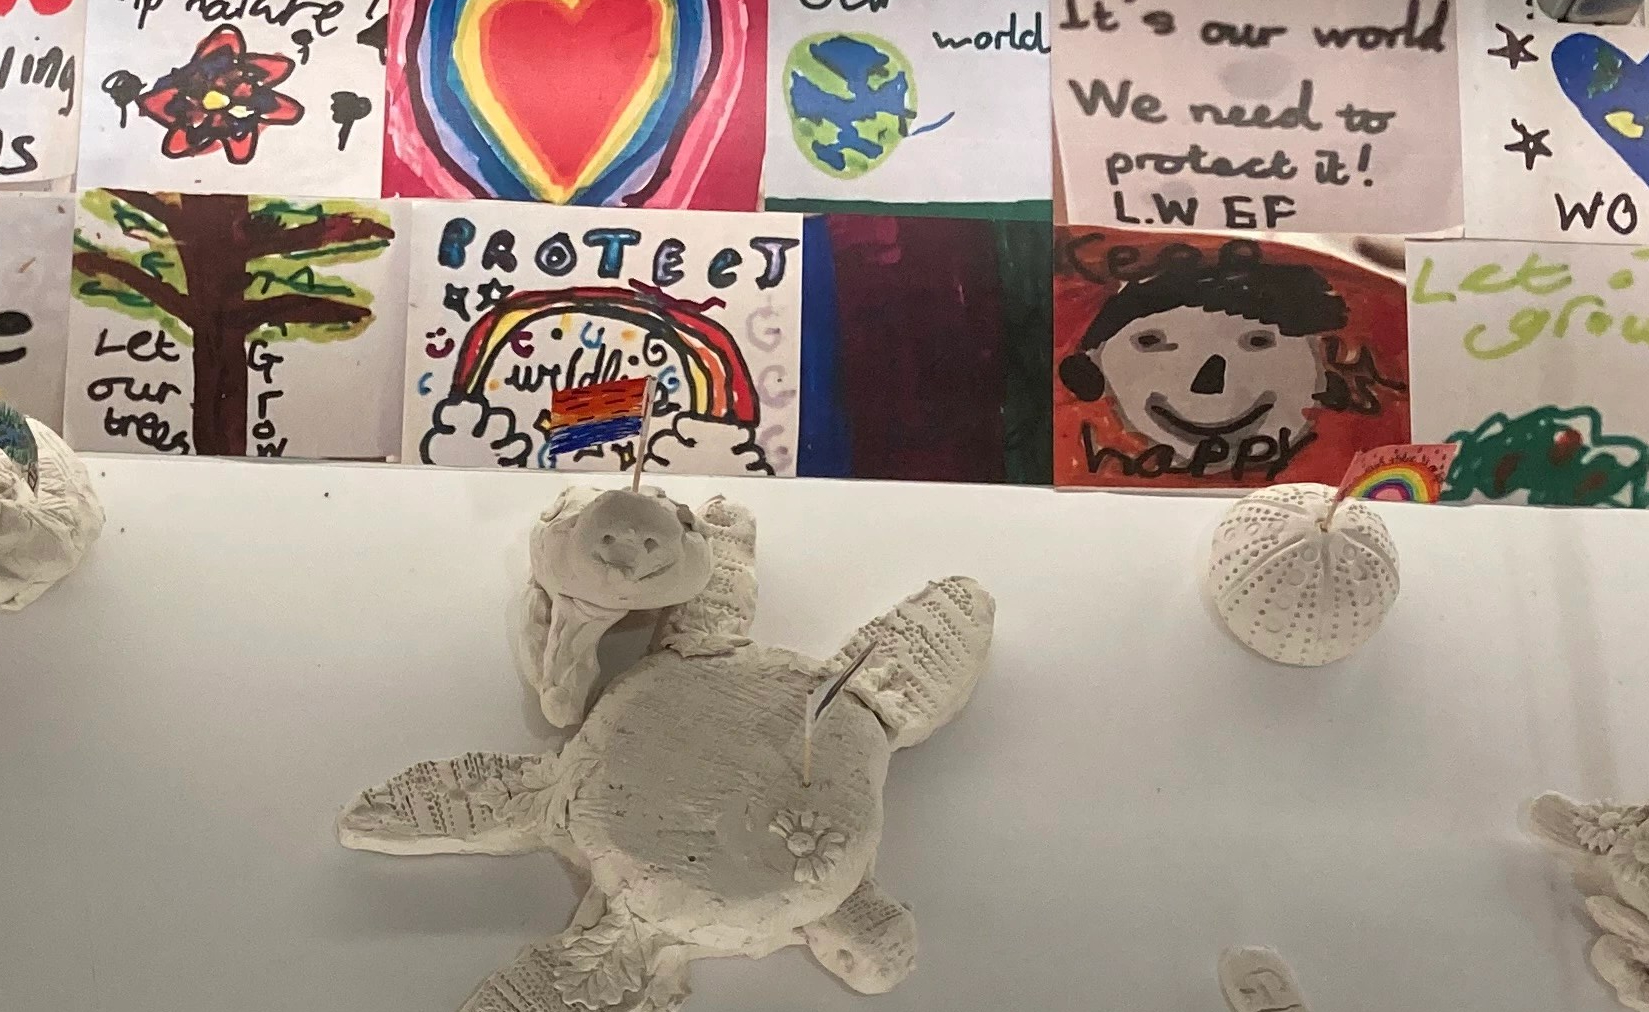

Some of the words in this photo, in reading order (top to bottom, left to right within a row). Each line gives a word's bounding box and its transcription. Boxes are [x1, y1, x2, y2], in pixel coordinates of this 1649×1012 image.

[932, 11, 1051, 54] world
[1201, 20, 1288, 48] our
[1313, 0, 1450, 53] world
[1068, 79, 1168, 124] We
[1189, 79, 1323, 132] need
[1335, 103, 1397, 134] to
[1106, 143, 1298, 186] protect
[1314, 142, 1373, 188] it!
[94, 328, 180, 362] Let
[87, 376, 182, 404] our
[104, 407, 191, 456] trees
[1081, 421, 1319, 481] happy
